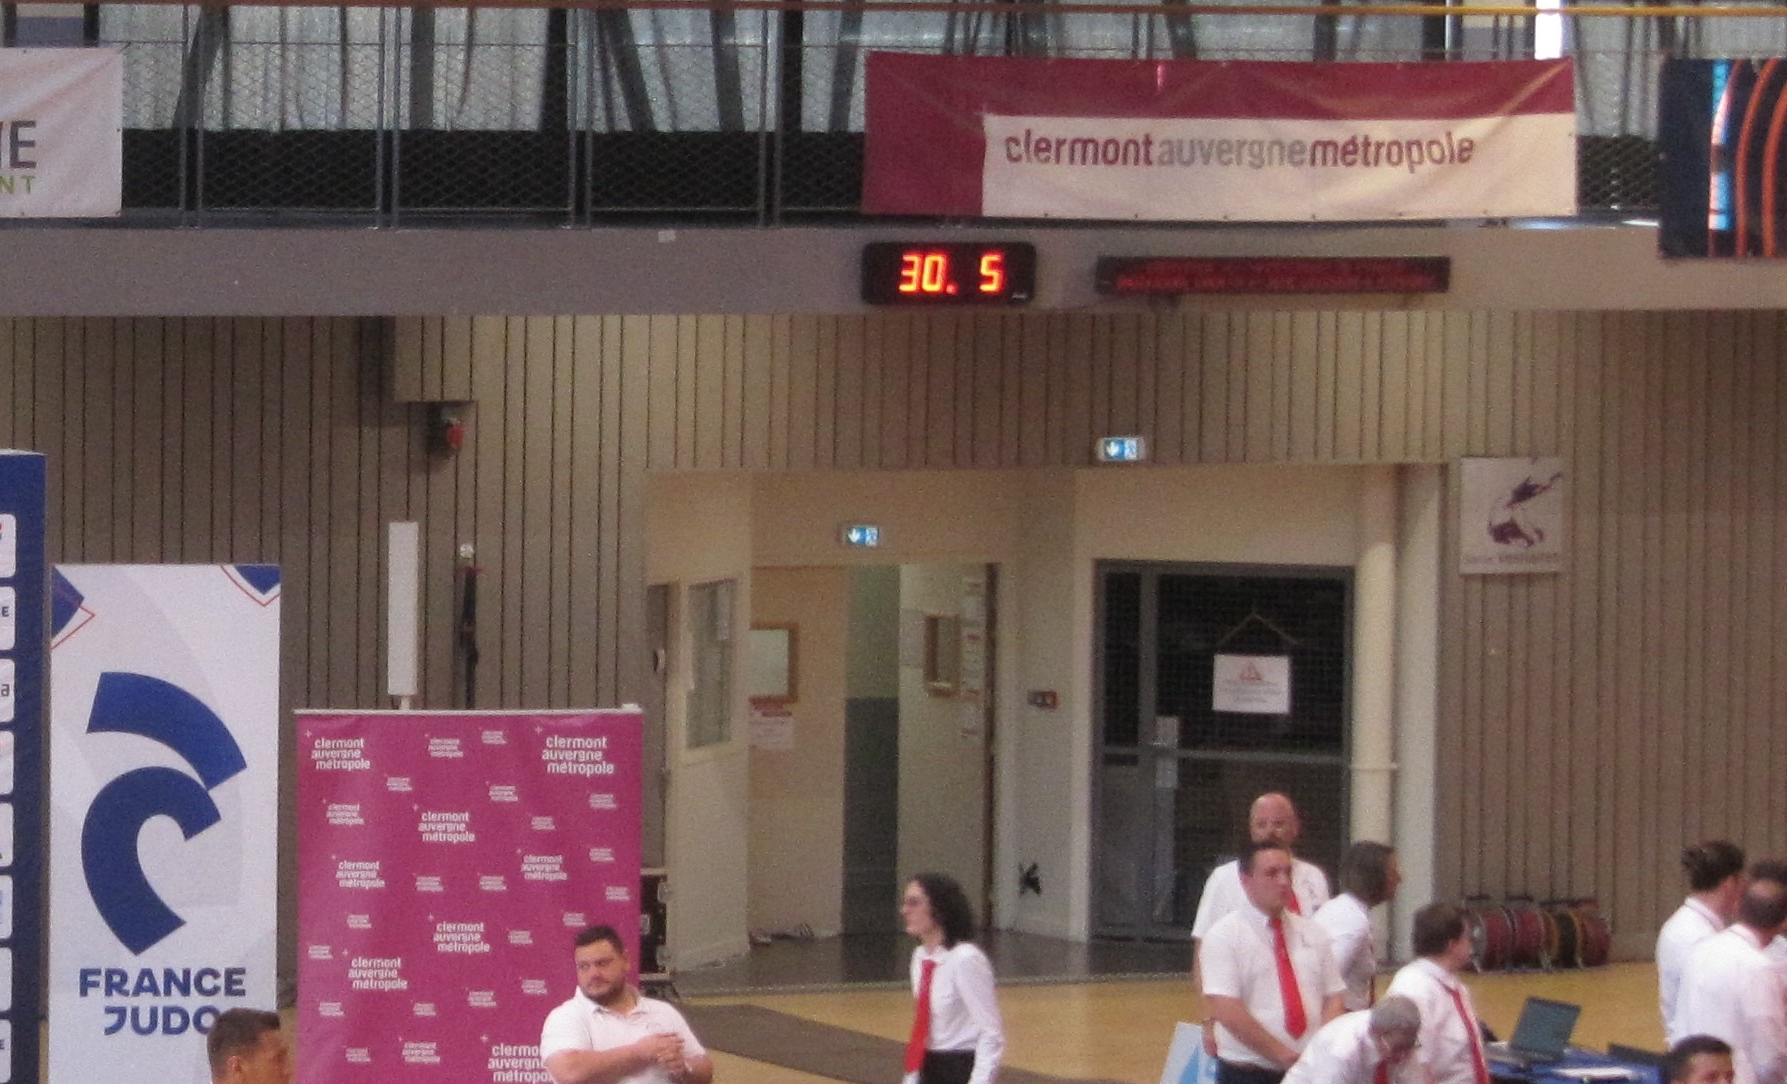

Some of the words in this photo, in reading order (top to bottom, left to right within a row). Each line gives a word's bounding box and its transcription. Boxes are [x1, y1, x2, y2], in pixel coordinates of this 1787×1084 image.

[546, 735, 607, 748] clermont
[542, 750, 602, 761] auvergne
[79, 967, 246, 997] FRANCE
[104, 1005, 221, 1036] JUDO
[492, 1043, 540, 1056] clermo
